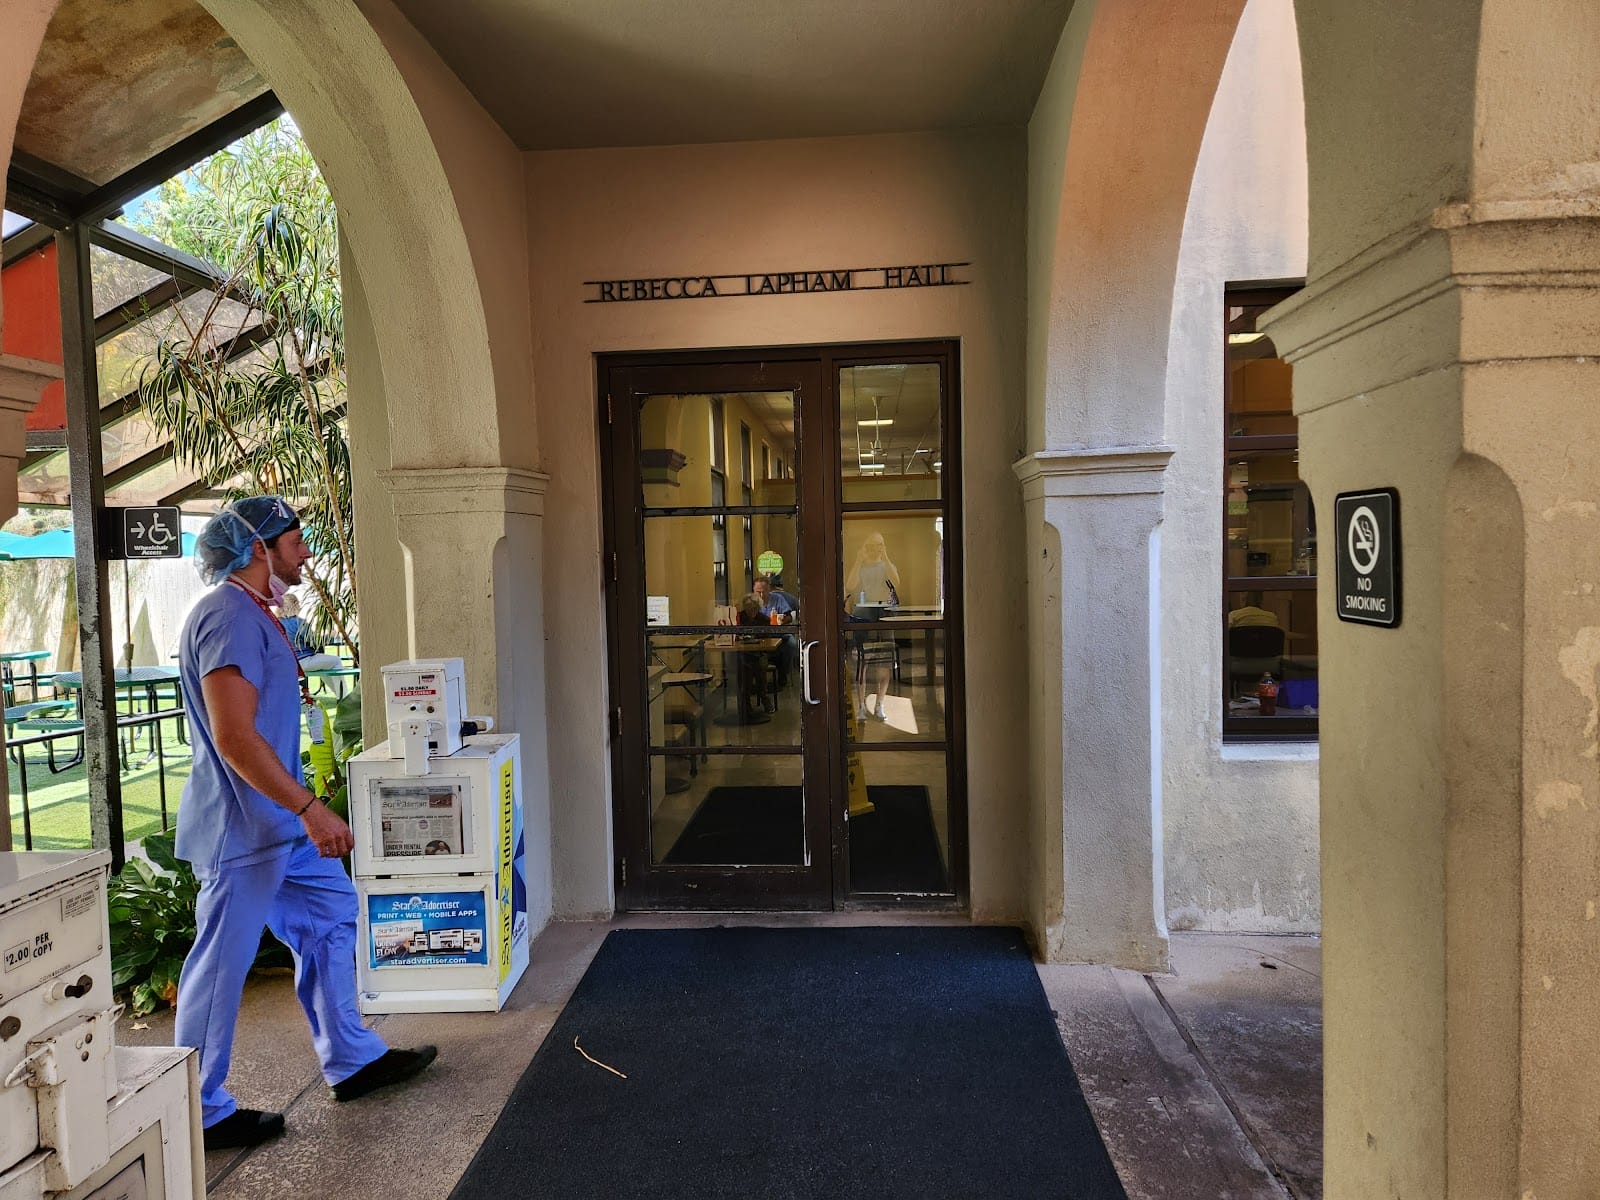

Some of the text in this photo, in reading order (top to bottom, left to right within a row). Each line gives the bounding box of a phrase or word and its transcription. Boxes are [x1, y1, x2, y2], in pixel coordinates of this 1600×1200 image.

[600, 265, 954, 301] REBECCA LAPHAM HALL
[1357, 577, 1372, 591] NO
[1345, 595, 1386, 612] SMOKING
[501, 770, 512, 882] Advertiser
[391, 900, 460, 911] Star Advertiser
[35, 932, 49, 945] PER
[5, 942, 53, 965] $2.00 COPY
[390, 957, 467, 965] staradvertiser.com
